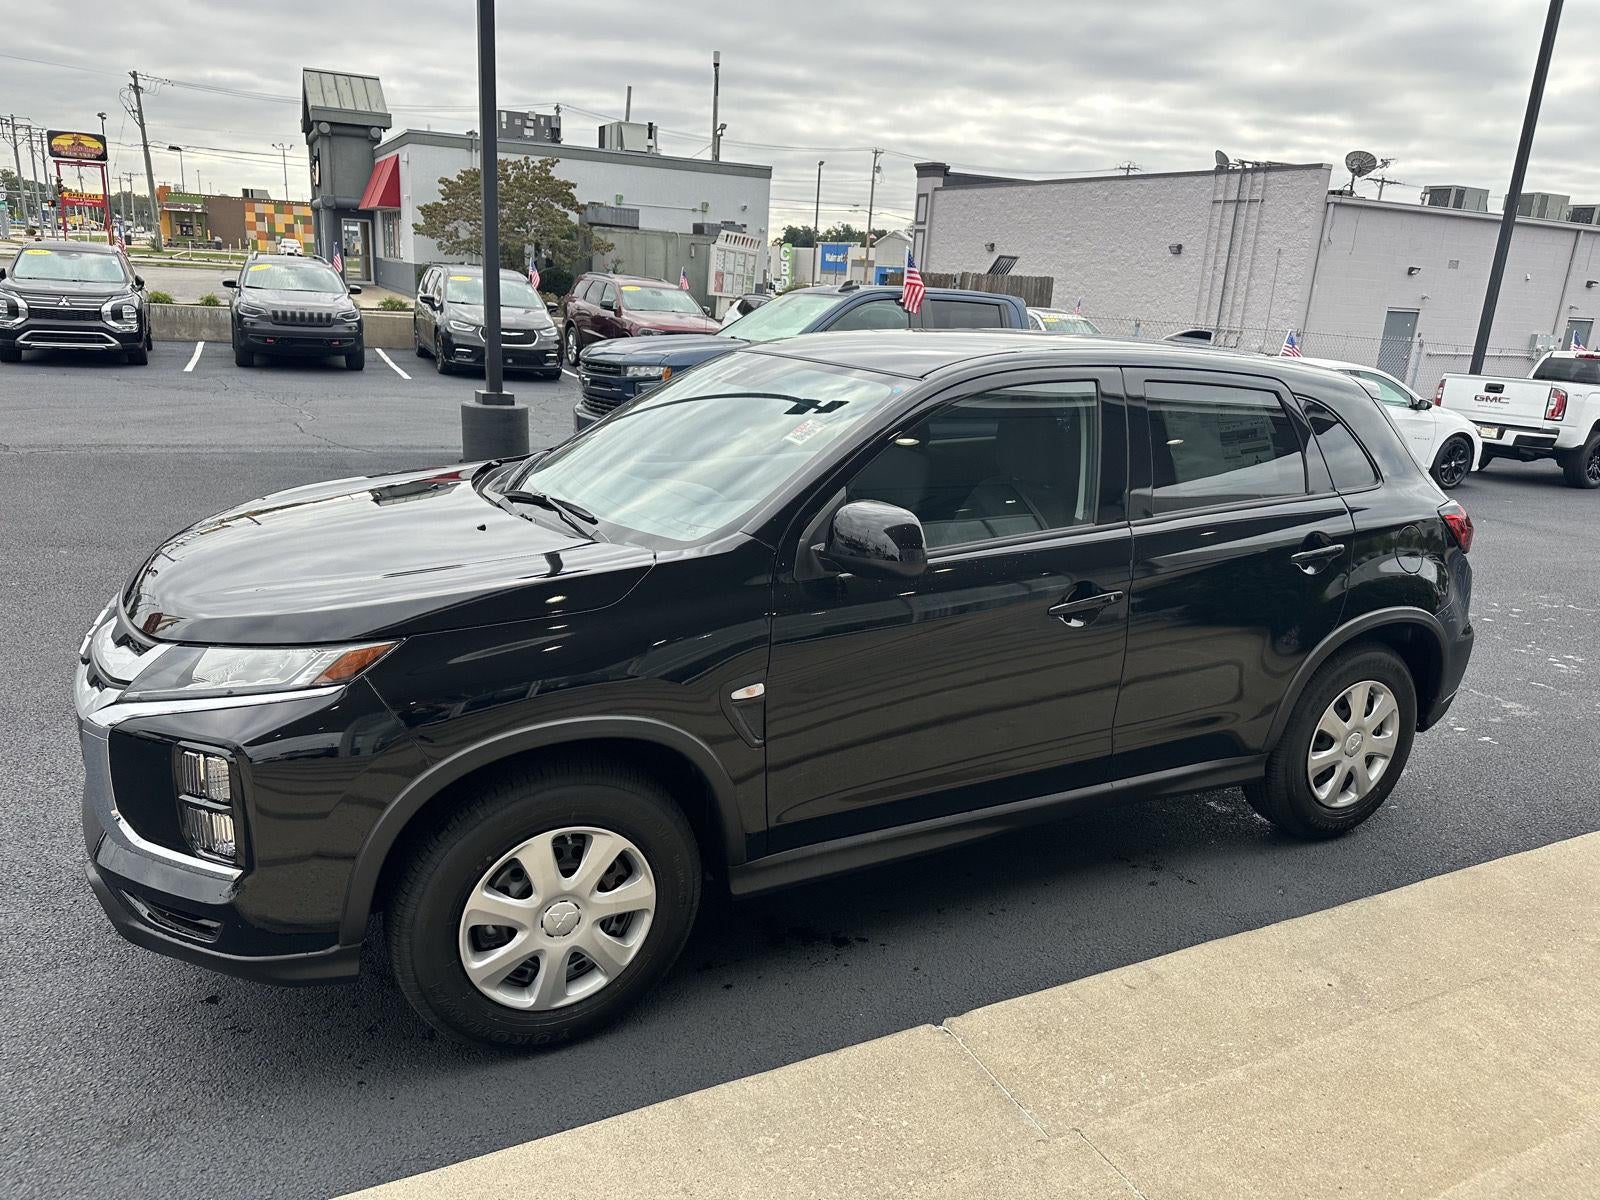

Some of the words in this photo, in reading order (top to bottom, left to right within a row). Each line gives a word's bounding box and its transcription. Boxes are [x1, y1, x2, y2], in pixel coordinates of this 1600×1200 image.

[825, 252, 844, 262] Walmart
[780, 246, 791, 289] CBD
[1474, 394, 1511, 404] GMC
